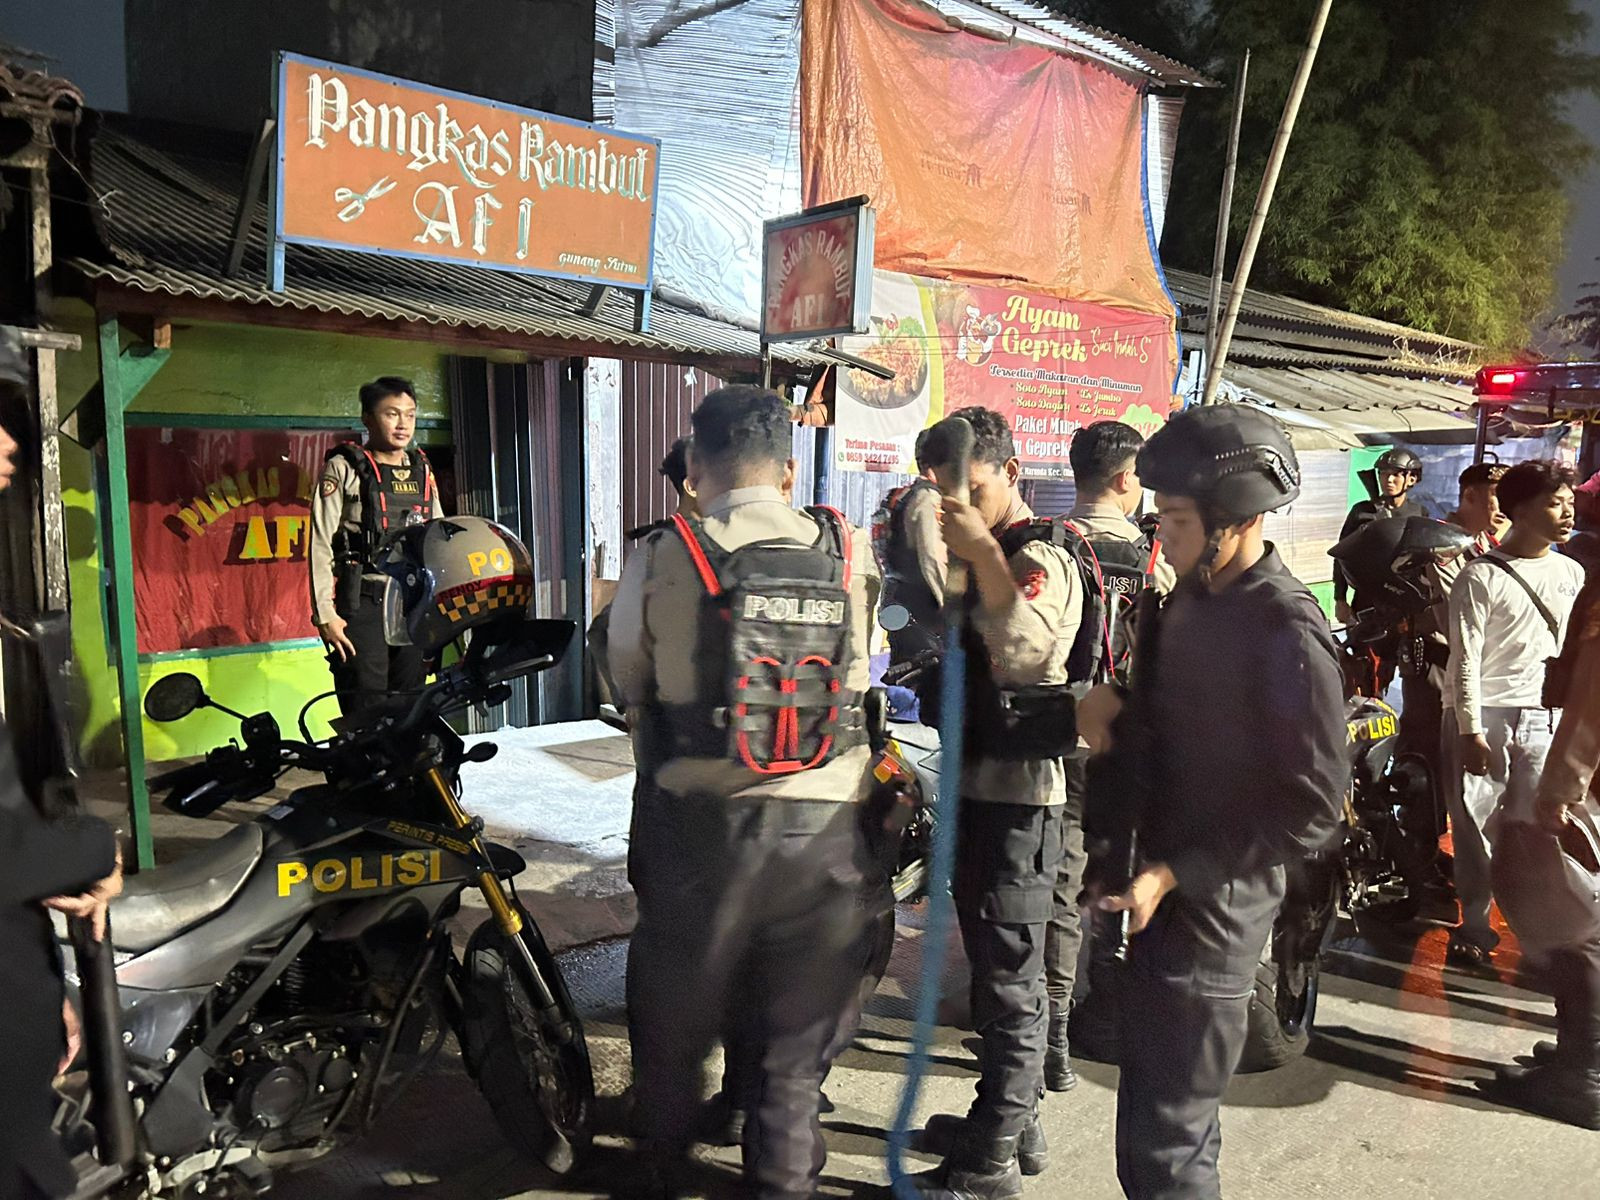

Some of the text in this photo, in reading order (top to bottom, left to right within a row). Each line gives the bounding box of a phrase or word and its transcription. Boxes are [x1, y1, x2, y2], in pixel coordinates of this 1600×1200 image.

[305, 73, 650, 202] Pangkas Rambut
[768, 230, 851, 309] PANGKAS RAMBUT
[791, 293, 826, 328] AFI
[1002, 295, 1082, 334] Ayam
[1002, 327, 1088, 362] Geprek
[990, 365, 1034, 379] Tersedia
[1080, 374, 1099, 386] dan
[1100, 378, 1143, 392] Minuman
[1015, 382, 1068, 397] Soto Ayam
[1016, 397, 1037, 408] Soto
[1093, 391, 1122, 403] Jumbo
[1093, 404, 1117, 417] Jeruk
[1015, 414, 1047, 434] Paket
[1026, 438, 1071, 459] Geprek
[744, 595, 845, 624] POLISI
[1347, 715, 1396, 743] POLISI
[278, 850, 441, 897] POLISI
